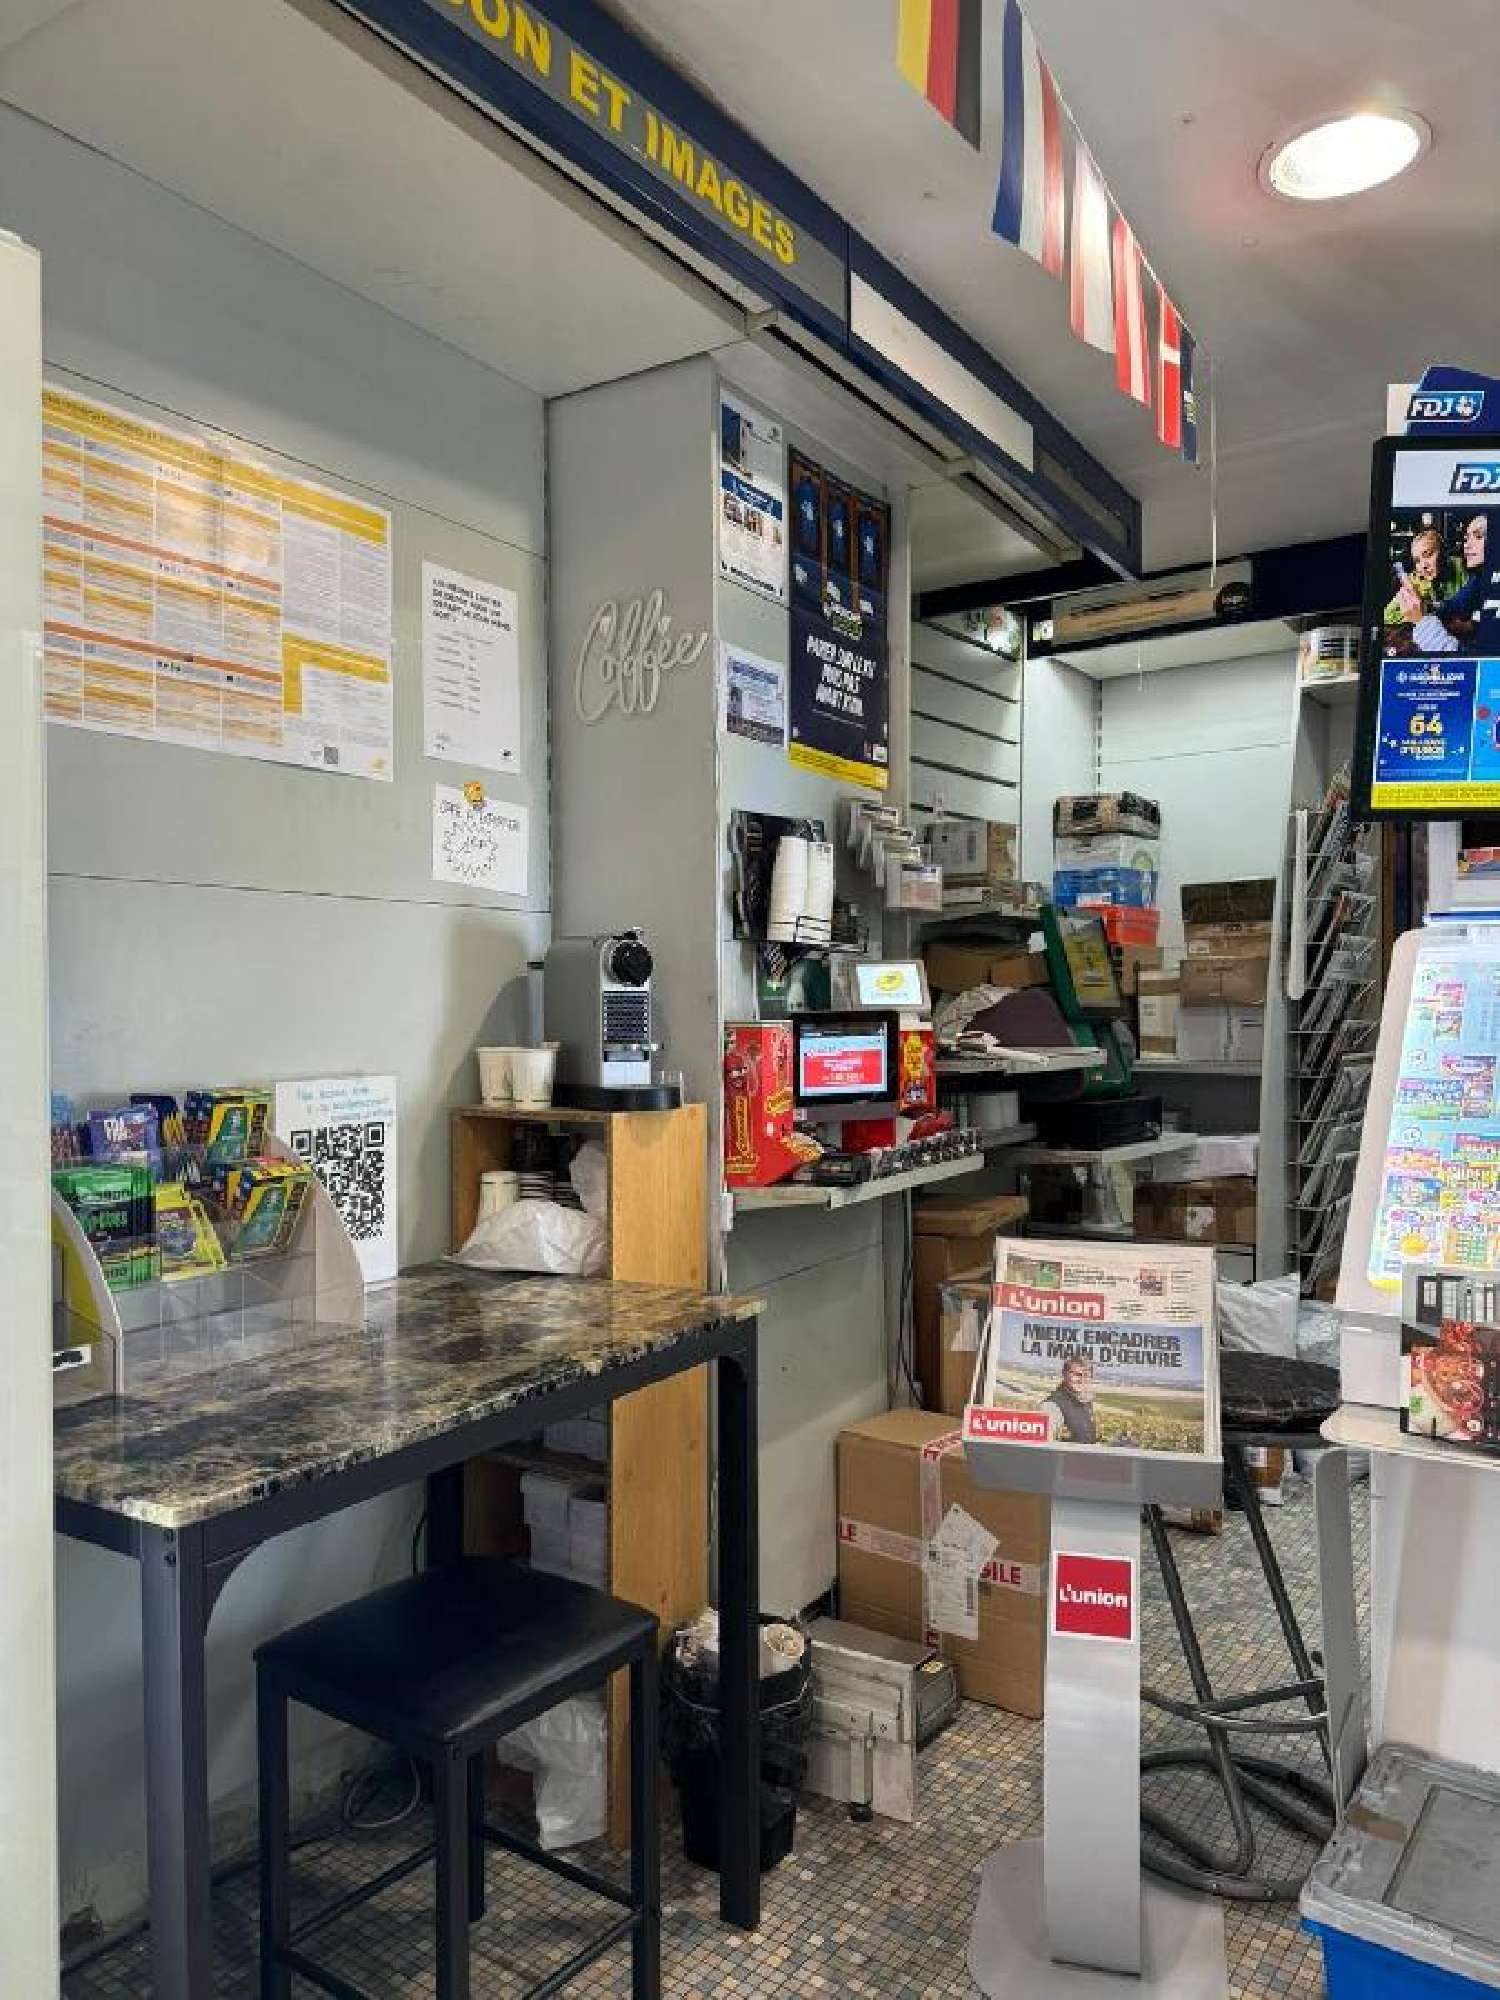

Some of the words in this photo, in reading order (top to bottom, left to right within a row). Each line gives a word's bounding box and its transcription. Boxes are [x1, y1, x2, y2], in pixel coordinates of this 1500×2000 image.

[448, 0, 552, 77] ON
[569, 48, 631, 132] ET
[645, 110, 797, 267] IMAGES
[1411, 396, 1454, 417] FDJ
[574, 587, 708, 726] Coffee
[1410, 713, 1443, 735] 64
[1009, 1290, 1101, 1318] L'union
[1023, 1323, 1081, 1342] MIEUX
[1084, 1328, 1181, 1352] ENCADRER
[1021, 1340, 1043, 1357] LA
[1047, 1342, 1094, 1362] MAIN
[972, 1414, 1045, 1435] L'union
[1059, 1583, 1129, 1609] L'union
